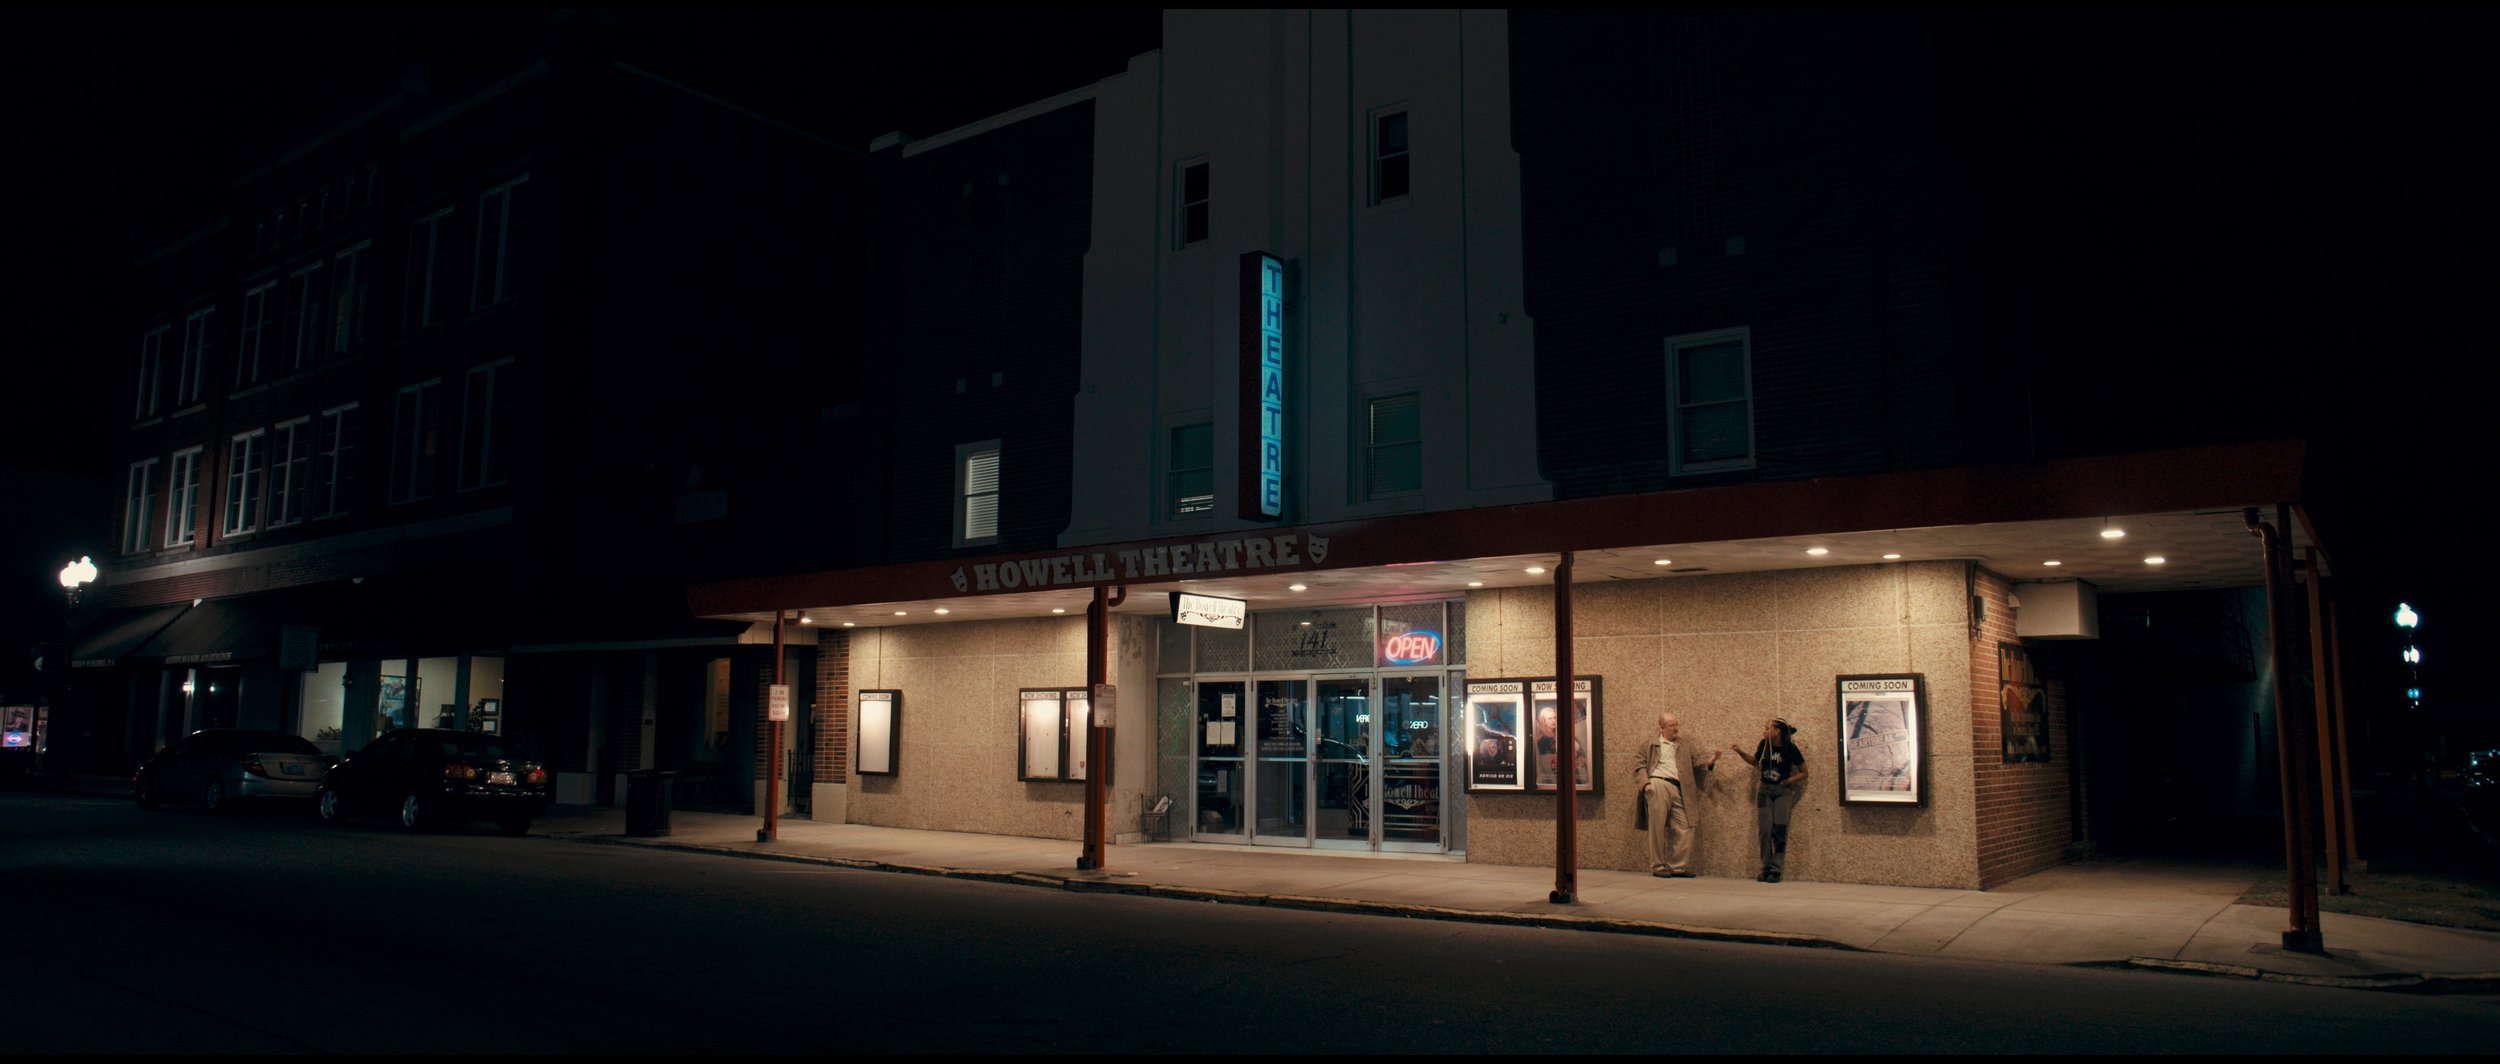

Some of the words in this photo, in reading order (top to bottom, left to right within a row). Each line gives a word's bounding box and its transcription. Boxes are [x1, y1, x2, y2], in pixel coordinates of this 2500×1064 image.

[1265, 264, 1282, 508] THEATRE
[974, 553, 1116, 590] HOWELL
[1118, 534, 1300, 578] THEATRE
[1300, 629, 1328, 650] 141
[1386, 636, 1435, 659] OPEN
[1847, 682, 1881, 690] COMING
[1883, 681, 1908, 690] SOON
